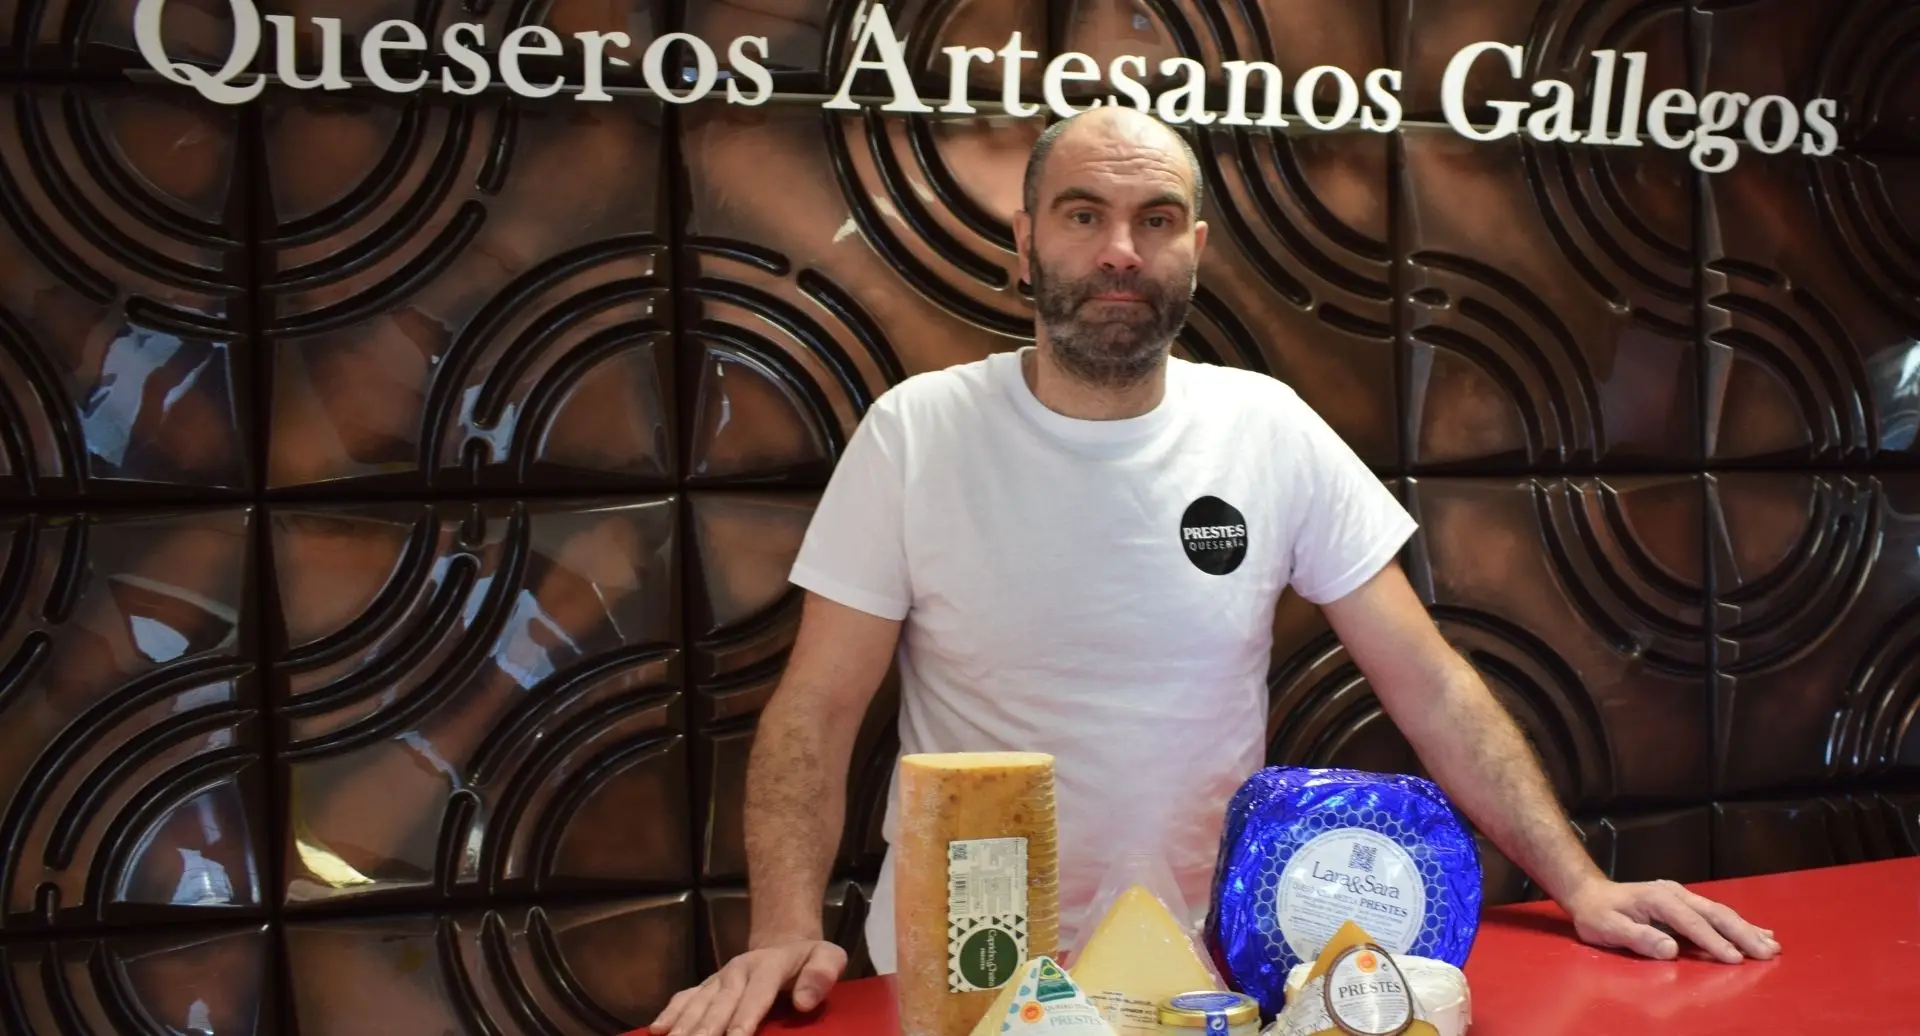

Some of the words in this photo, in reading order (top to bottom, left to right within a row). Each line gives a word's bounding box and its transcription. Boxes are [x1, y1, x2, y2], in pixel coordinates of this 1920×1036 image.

[134, 0, 773, 105] Queseros
[823, 3, 1402, 133] Artesanos
[1441, 41, 1838, 173] Gallegos
[1182, 524, 1245, 539] PRESTES
[1312, 861, 1400, 899] Lara&Sara
[1360, 897, 1408, 917] PRESTES
[1338, 981, 1401, 998] PRESTES
